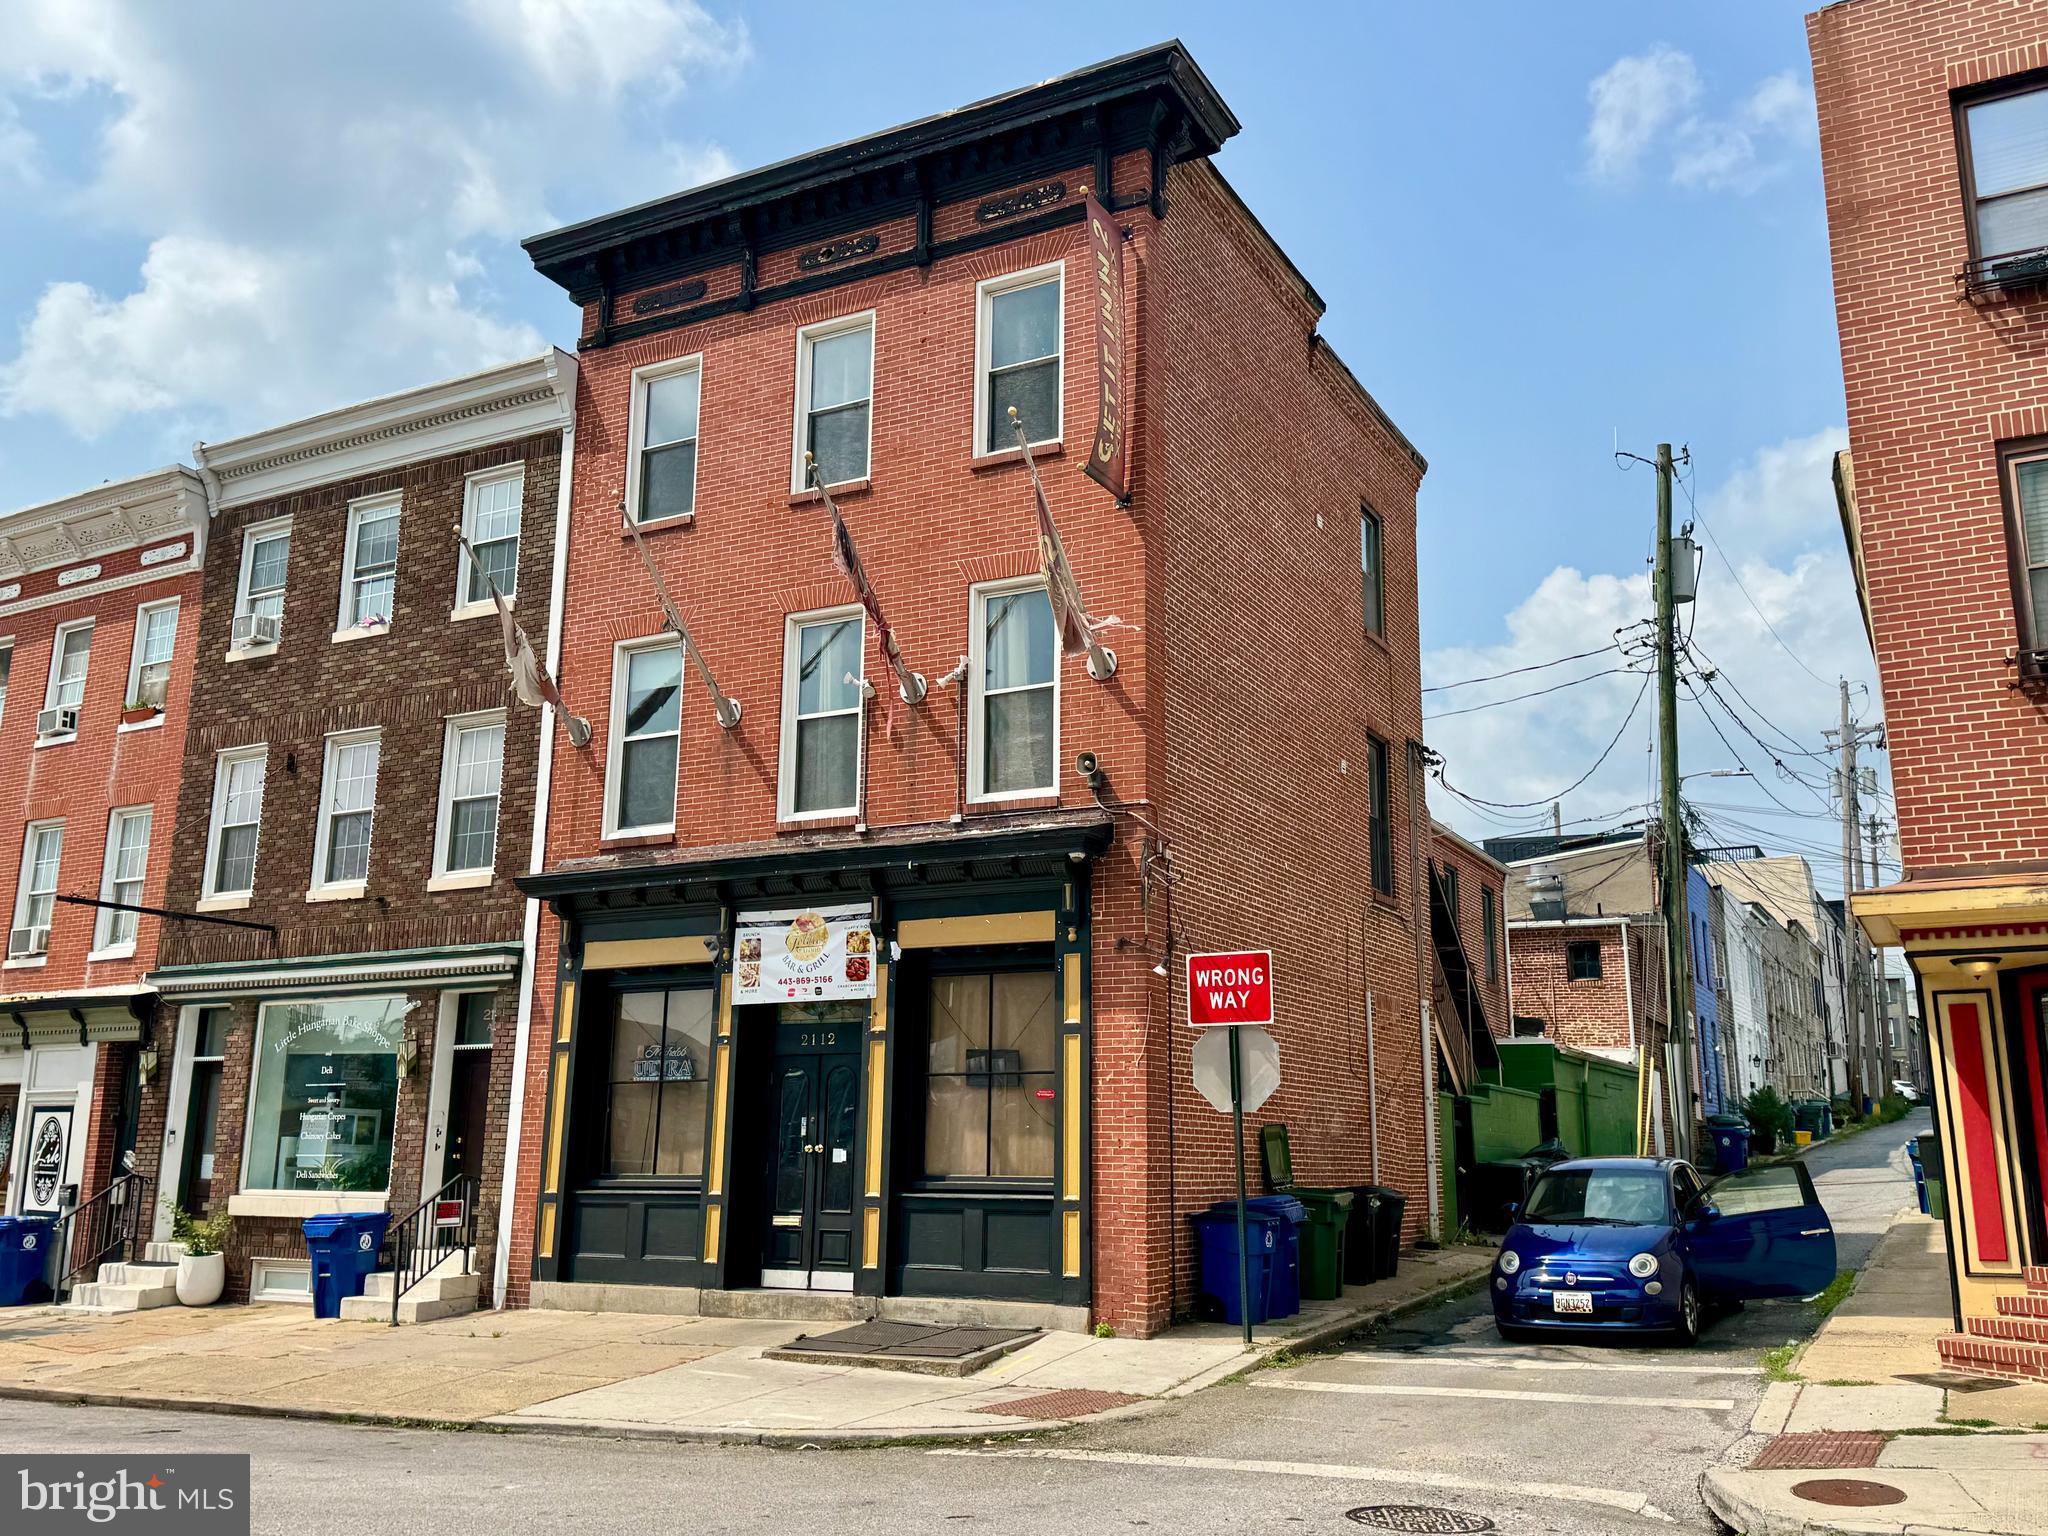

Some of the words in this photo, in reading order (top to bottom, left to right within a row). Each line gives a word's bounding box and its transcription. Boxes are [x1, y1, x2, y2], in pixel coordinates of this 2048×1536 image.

[782, 955, 797, 972] BAR
[797, 965, 805, 974] &
[805, 952, 831, 973] GRILL
[778, 975, 833, 986] 443-869-5166
[1196, 967, 1264, 988] WRONG
[1209, 990, 1251, 1009] WAY
[274, 1031, 297, 1053] Little
[298, 1016, 340, 1036] Hungarian
[343, 1015, 361, 1030] Bake
[362, 1020, 391, 1049] Shoppe
[801, 1032, 835, 1046] 2112
[645, 1045, 688, 1058] Mchelob
[321, 1066, 333, 1075] Deli
[319, 1096, 327, 1104] and
[328, 1111, 346, 1123] Crepes
[325, 1131, 341, 1140] Cakes
[296, 1170, 308, 1179] Deli
[308, 1170, 339, 1179] Sandwiches
